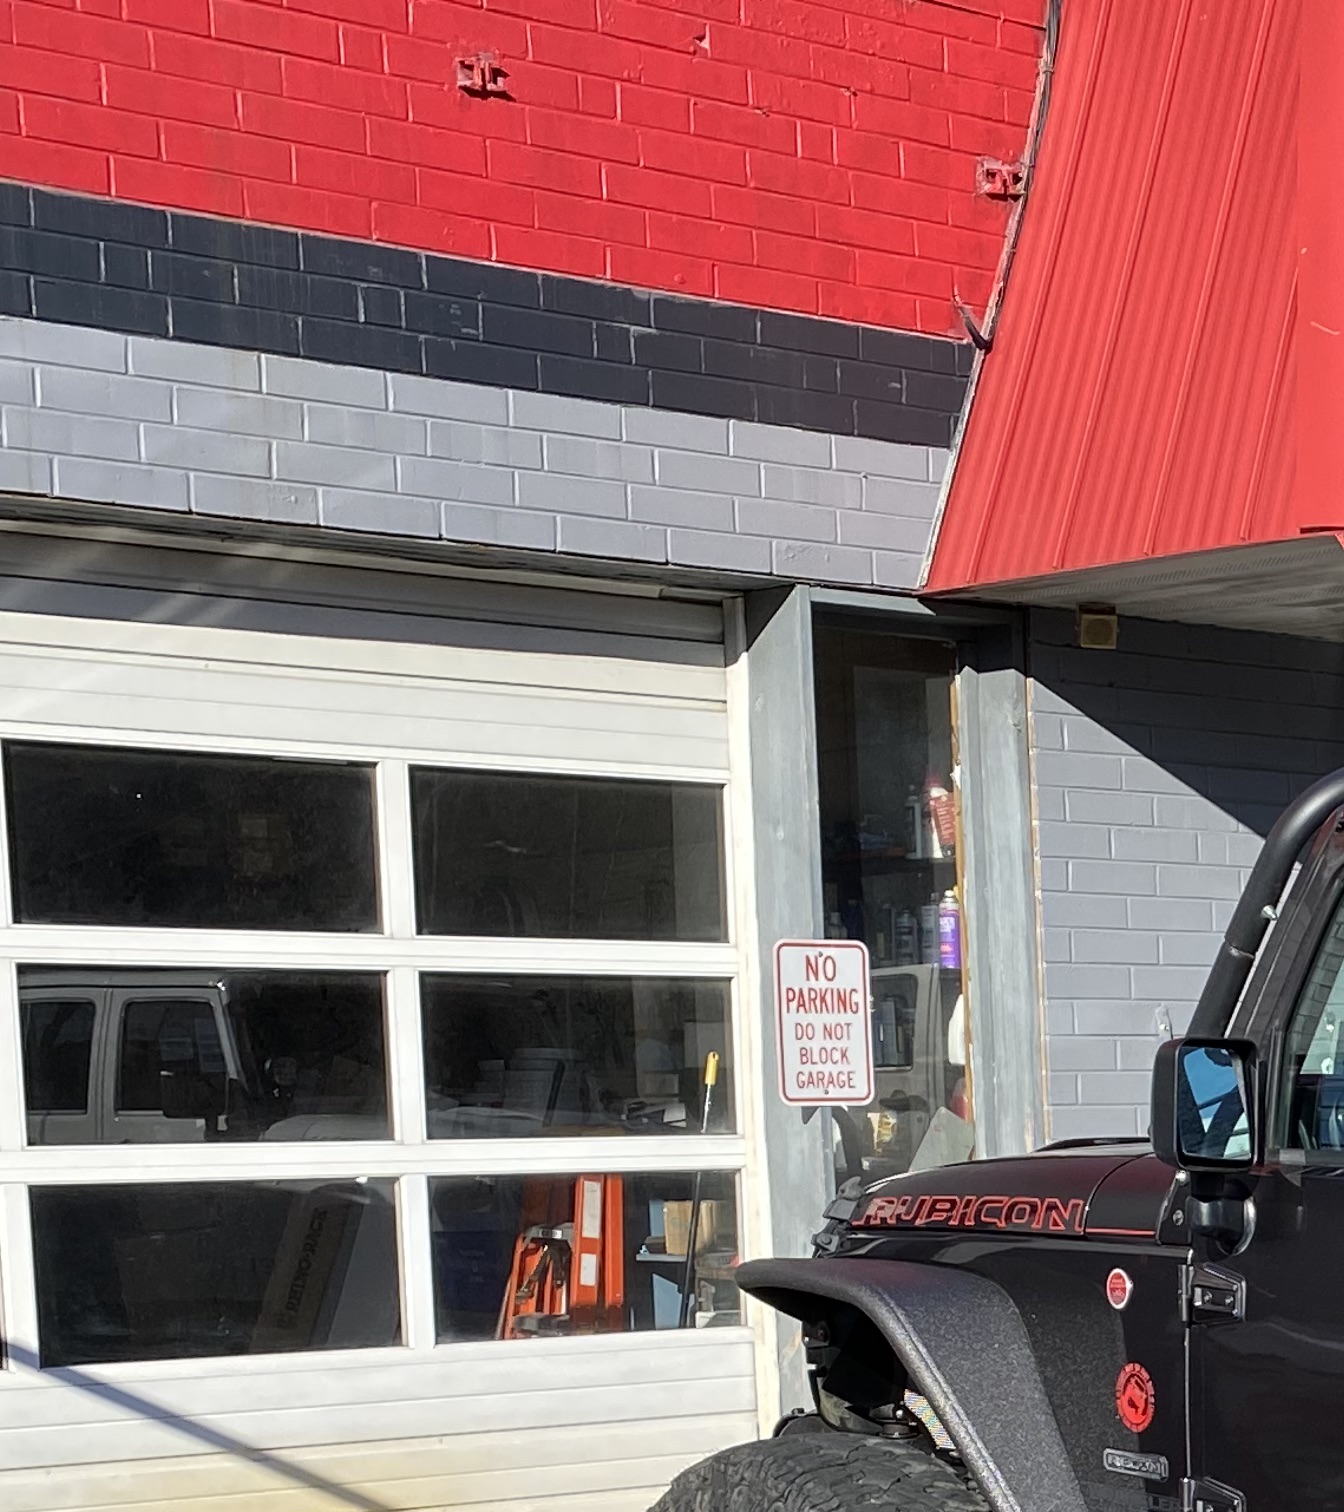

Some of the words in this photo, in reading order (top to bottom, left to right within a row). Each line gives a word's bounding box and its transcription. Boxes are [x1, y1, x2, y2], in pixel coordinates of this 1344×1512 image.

[805, 954, 837, 982] NO
[785, 987, 860, 1015] PARKING
[794, 1022, 815, 1041] DO
[823, 1022, 853, 1041] NOT
[799, 1047, 850, 1066] BLOCK
[796, 1071, 857, 1089] GARAGE
[853, 1195, 1087, 1236] RUBICON
